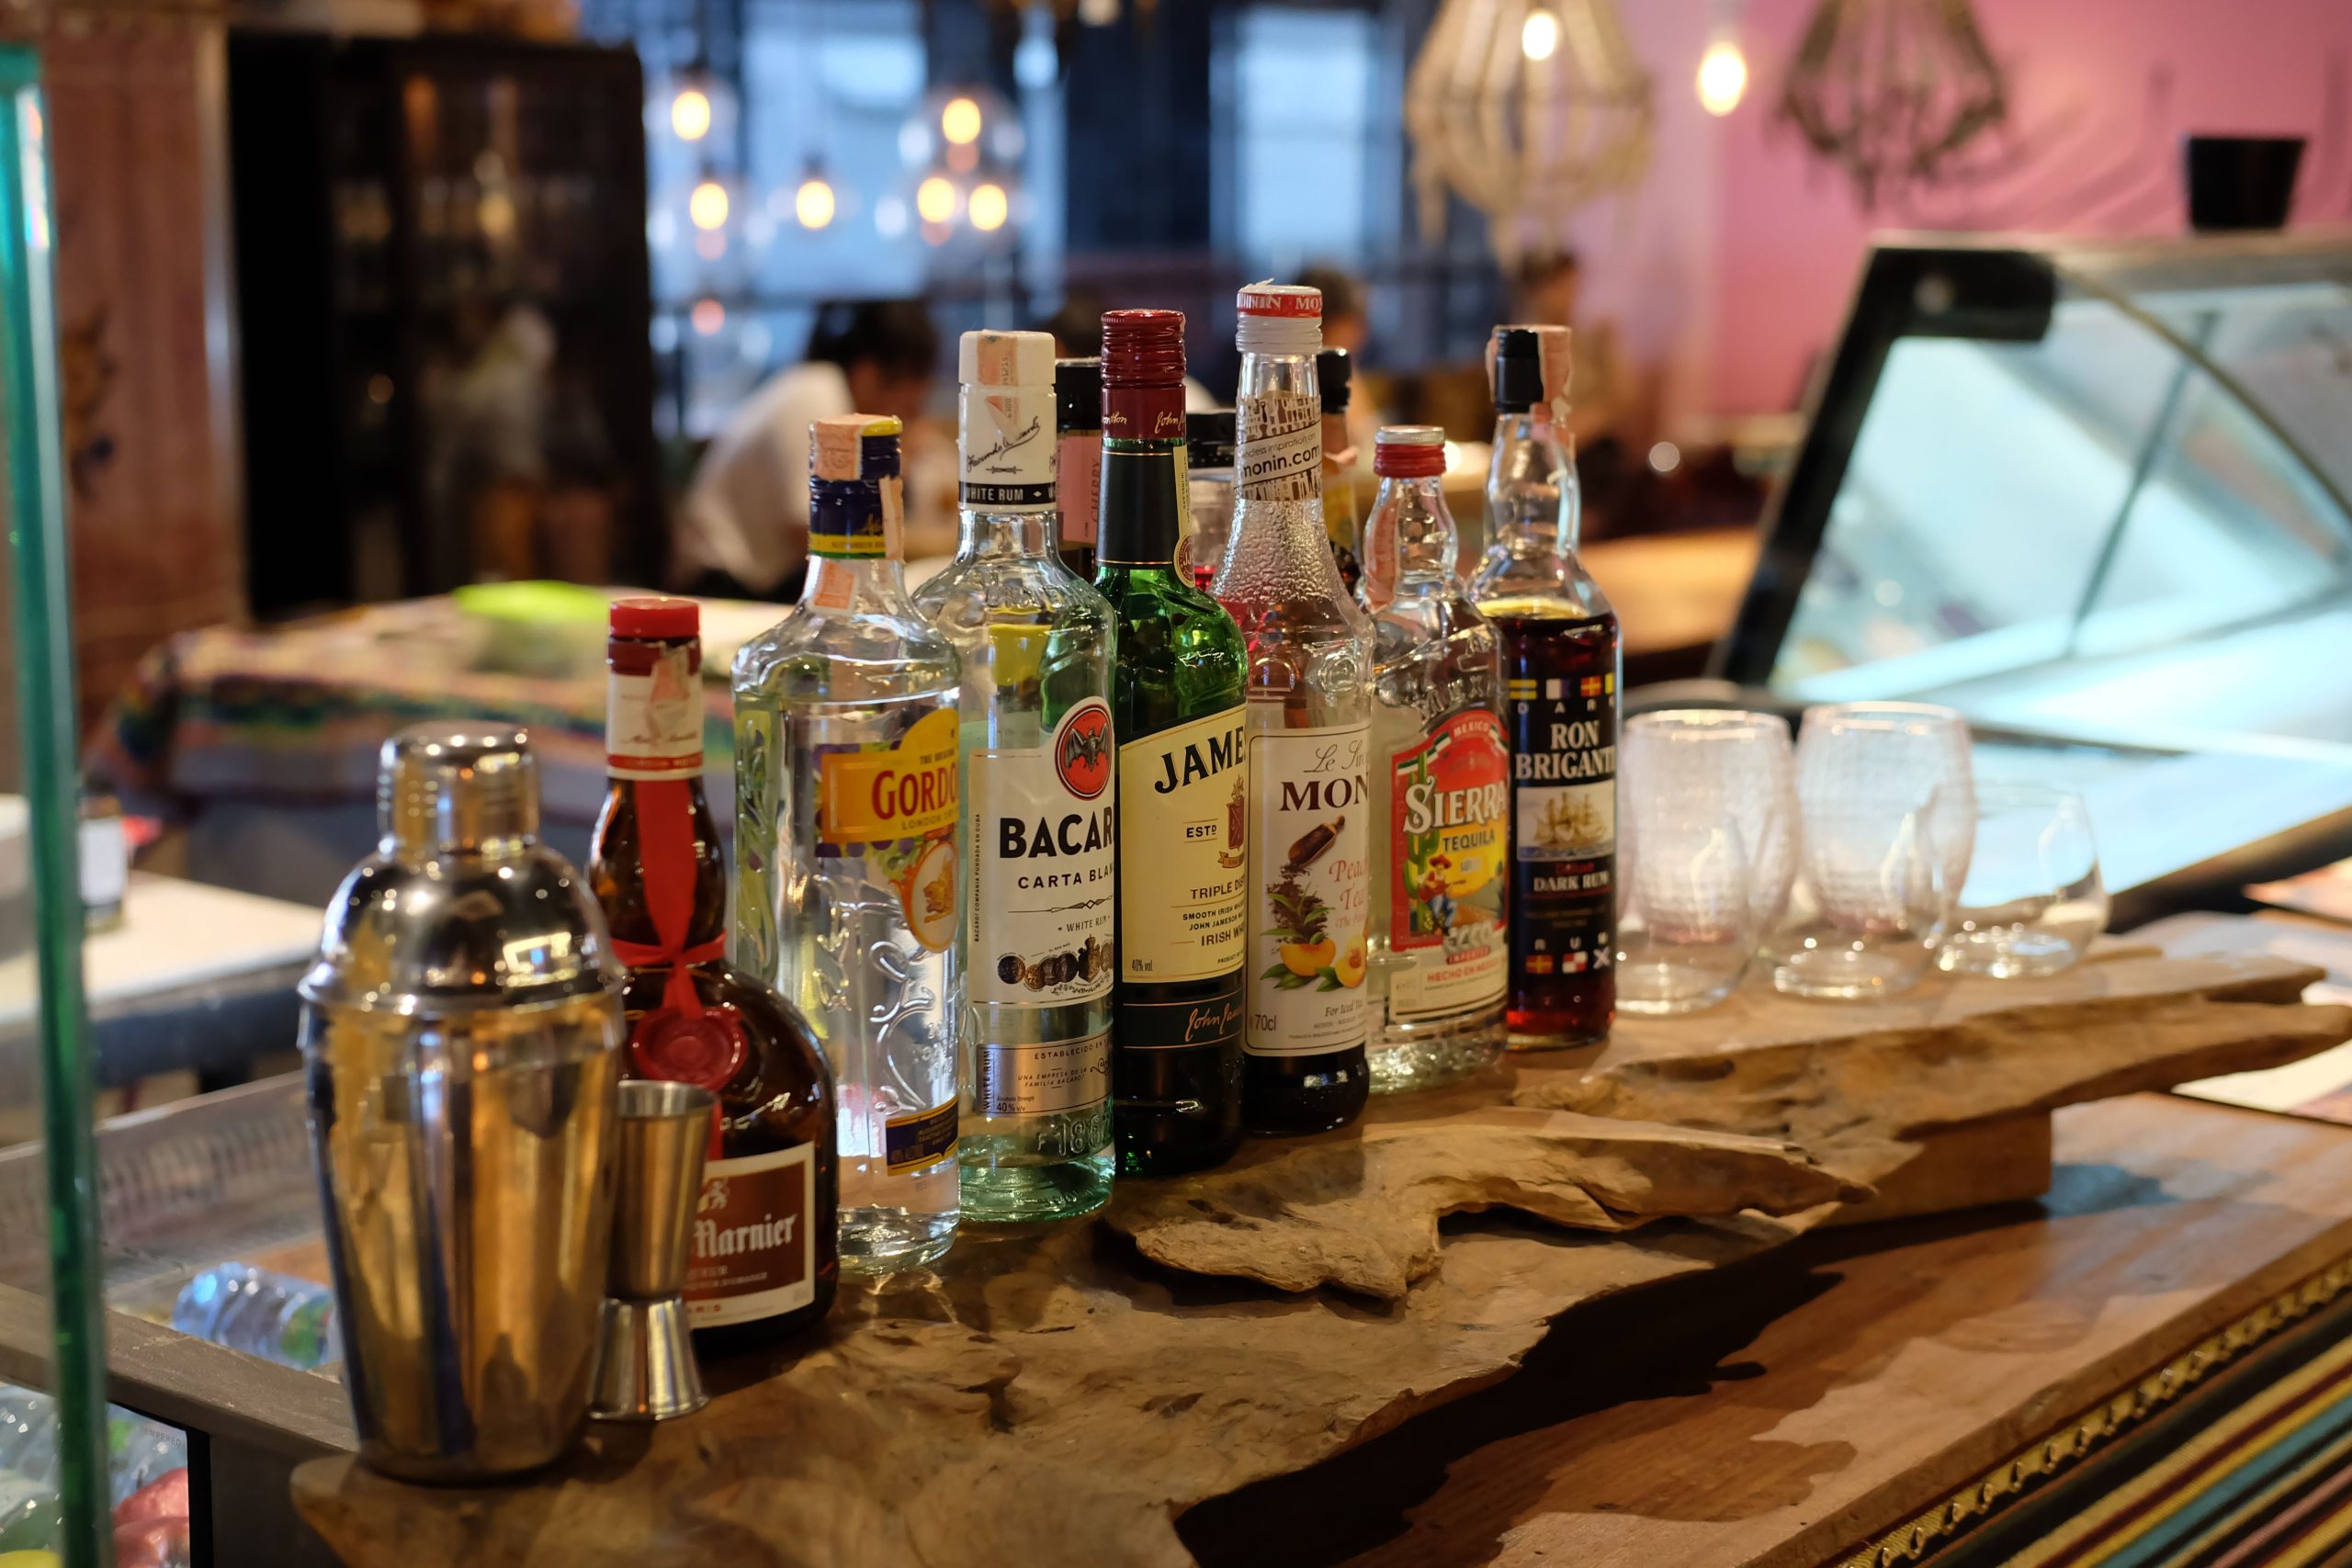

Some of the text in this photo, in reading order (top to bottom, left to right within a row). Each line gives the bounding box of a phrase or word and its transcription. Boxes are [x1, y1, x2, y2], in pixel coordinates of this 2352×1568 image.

[1155, 412, 1178, 434] John
[999, 488, 1023, 502] RUM
[1453, 720, 1489, 737] MEXICO
[1551, 720, 1600, 750] RON
[1303, 743, 1338, 773] Le
[1403, 775, 1507, 834] SIERRA
[1442, 829, 1495, 852] TEQUILA
[1018, 872, 1082, 889] CARTA
[1533, 870, 1609, 892] DARK RUM
[1191, 882, 1232, 899] TRIPLE
[1182, 909, 1216, 920] SMOOTH
[1217, 906, 1233, 916] IRISH
[1067, 915, 1107, 932] WHITE RUM
[1189, 920, 1210, 931] JOHN
[1213, 915, 1237, 928] JAMESON
[1201, 930, 1231, 947] IRISH
[1131, 958, 1144, 972] 40%
[1185, 1008, 1220, 1043] John
[1255, 1014, 1277, 1031] 70cl
[1035, 1043, 1093, 1060] ESTABLECIDO
[1036, 1071, 1068, 1080] EMPRESA
